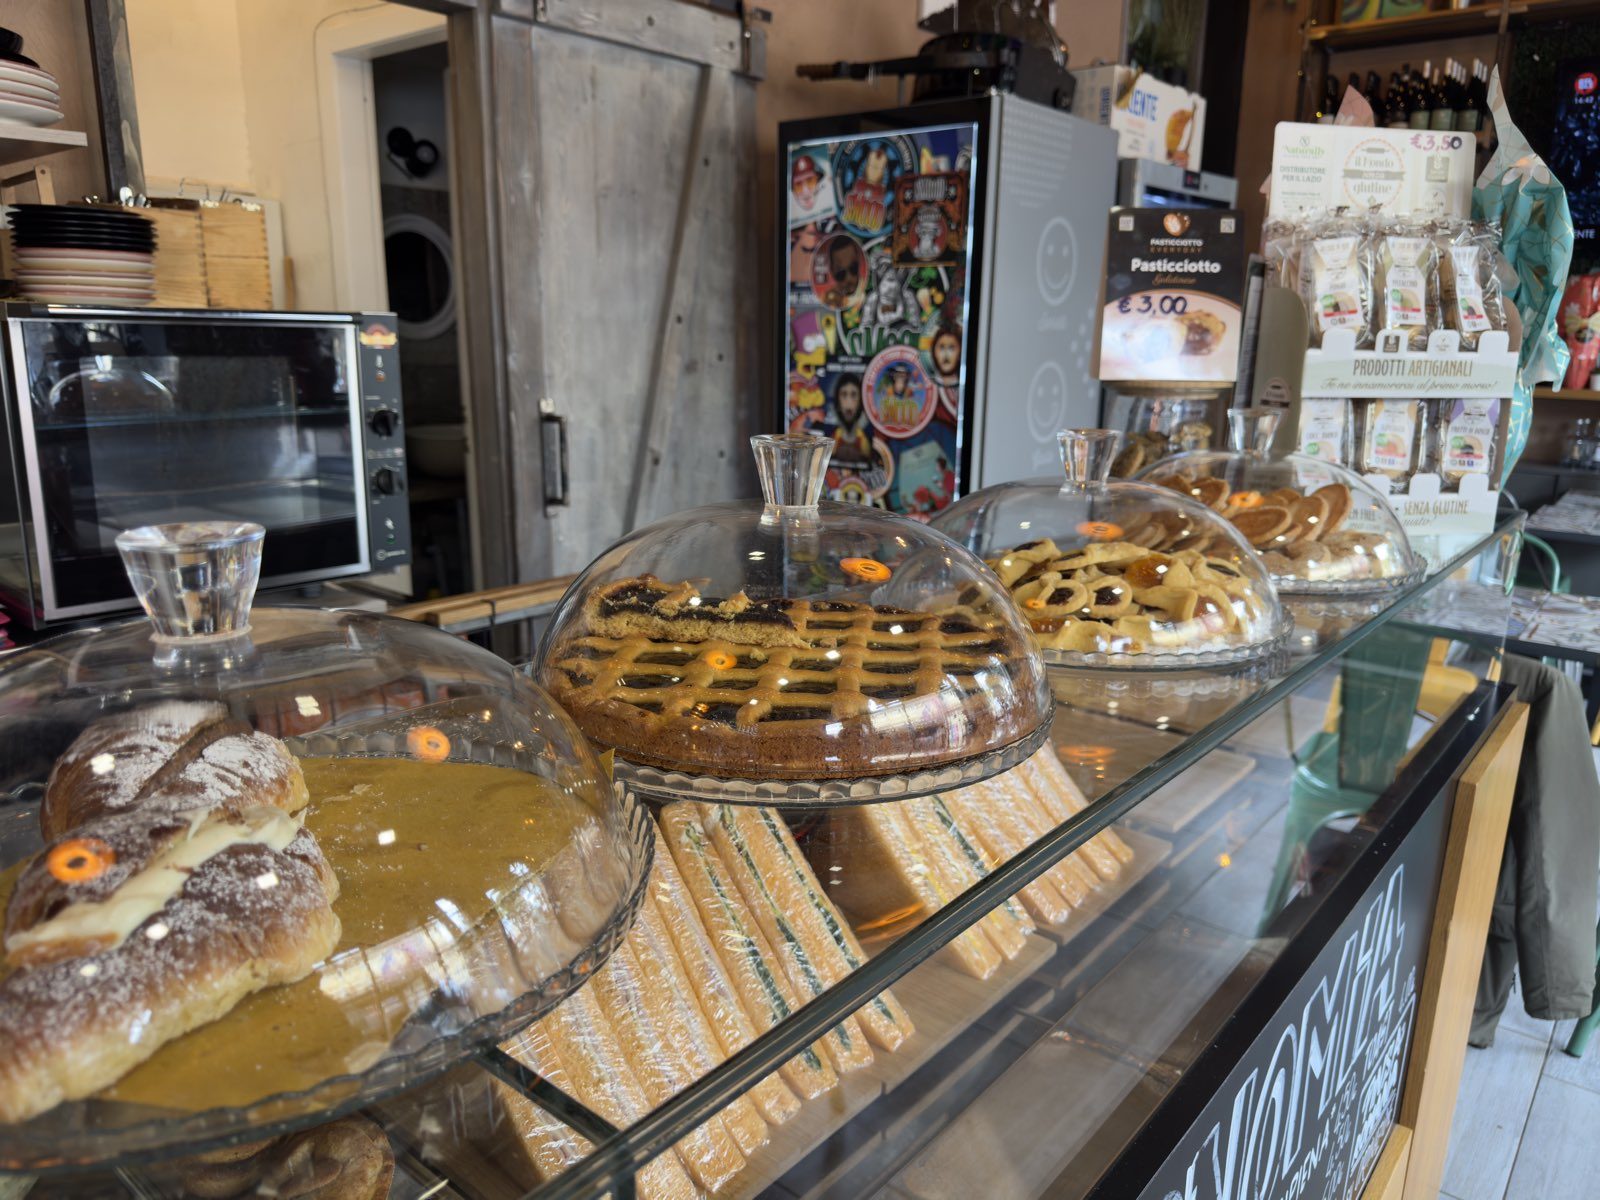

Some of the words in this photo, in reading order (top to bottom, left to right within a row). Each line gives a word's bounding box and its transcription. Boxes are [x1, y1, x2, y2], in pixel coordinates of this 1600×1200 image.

[1409, 133, 1463, 152] €3,50
[1279, 164, 1327, 175] DISTRIBUTORE
[1150, 238, 1204, 247] PASTICCIOTTO
[1130, 257, 1222, 274] Pasticciotto
[1118, 295, 1132, 314] €
[1137, 295, 1188, 315] 3,00
[1352, 359, 1405, 376] PRODOTTI
[1407, 360, 1474, 377] ARTIGIANALI
[1403, 501, 1430, 516] SENZA
[1432, 500, 1469, 519] GLUTINE
